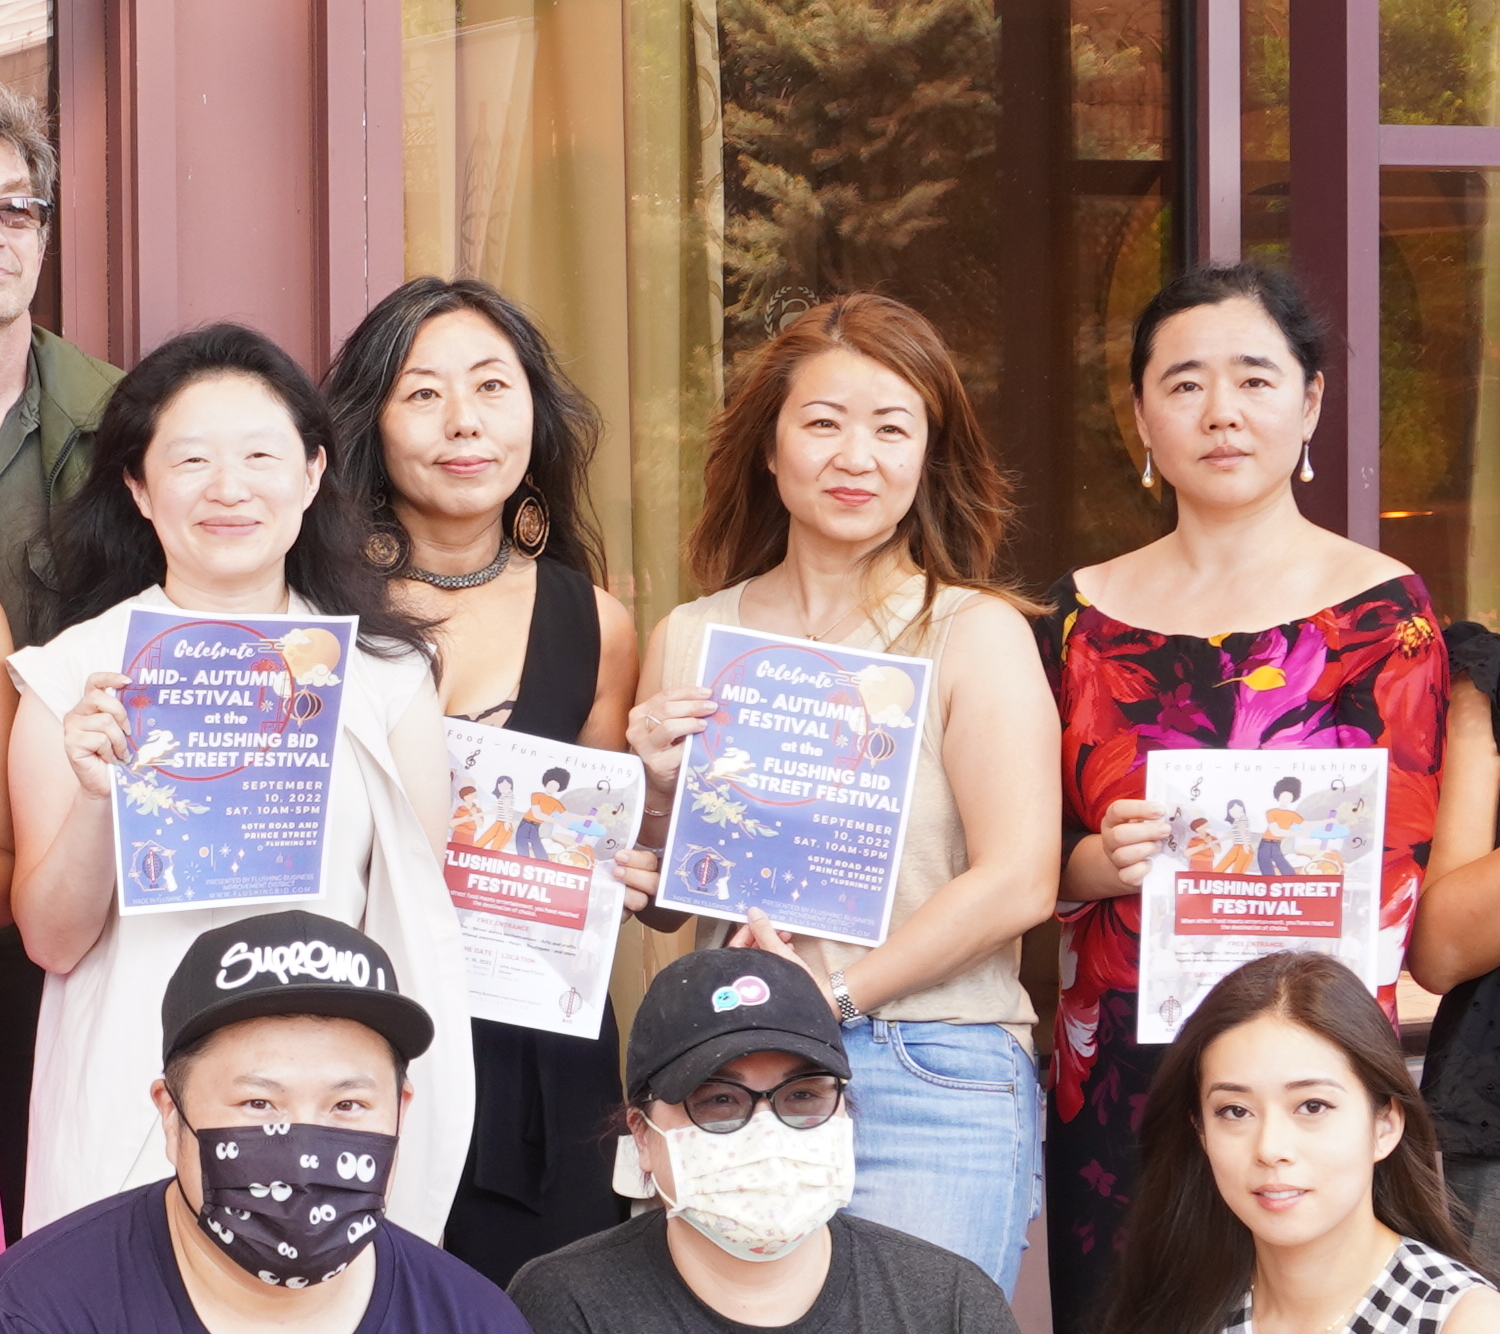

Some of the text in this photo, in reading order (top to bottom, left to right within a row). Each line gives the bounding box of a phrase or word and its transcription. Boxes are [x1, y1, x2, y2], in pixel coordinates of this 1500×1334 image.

[173, 639, 257, 660] Celebrate
[193, 670, 286, 687] AUTUMN
[755, 659, 834, 689] Celebrate
[158, 689, 254, 707] FESTIVAL
[771, 693, 862, 722] AUTUMN
[204, 711, 249, 724] at the
[737, 708, 830, 739] FESTIVAL
[187, 731, 319, 748] FLUSHING BID
[780, 741, 824, 756] at the
[172, 752, 330, 768] STREET FESTIVAL
[447, 728, 632, 778] Food Fun Flushing
[763, 756, 891, 790] FLUSHING BID
[1165, 761, 1367, 772] Food Fun Flushing
[241, 780, 323, 791] SEPTEMBER
[747, 772, 901, 813] STREET FESTIVAL
[289, 793, 322, 803] 2022
[256, 805, 321, 815] 10AM-5PM
[268, 821, 295, 830] ROAD
[298, 821, 319, 829] AND
[812, 813, 893, 836] SEPTEMBER
[244, 831, 318, 840] PRINCE STREET
[857, 834, 890, 848] 2022
[824, 841, 888, 860] 10AM-5PM
[834, 859, 862, 870] ROAD
[864, 865, 886, 875] AND
[523, 864, 589, 891] STREET
[467, 873, 552, 904] FESTIVAL
[1177, 878, 1340, 898] FLUSHING STREET
[1211, 898, 1303, 917] FESTIVAL
